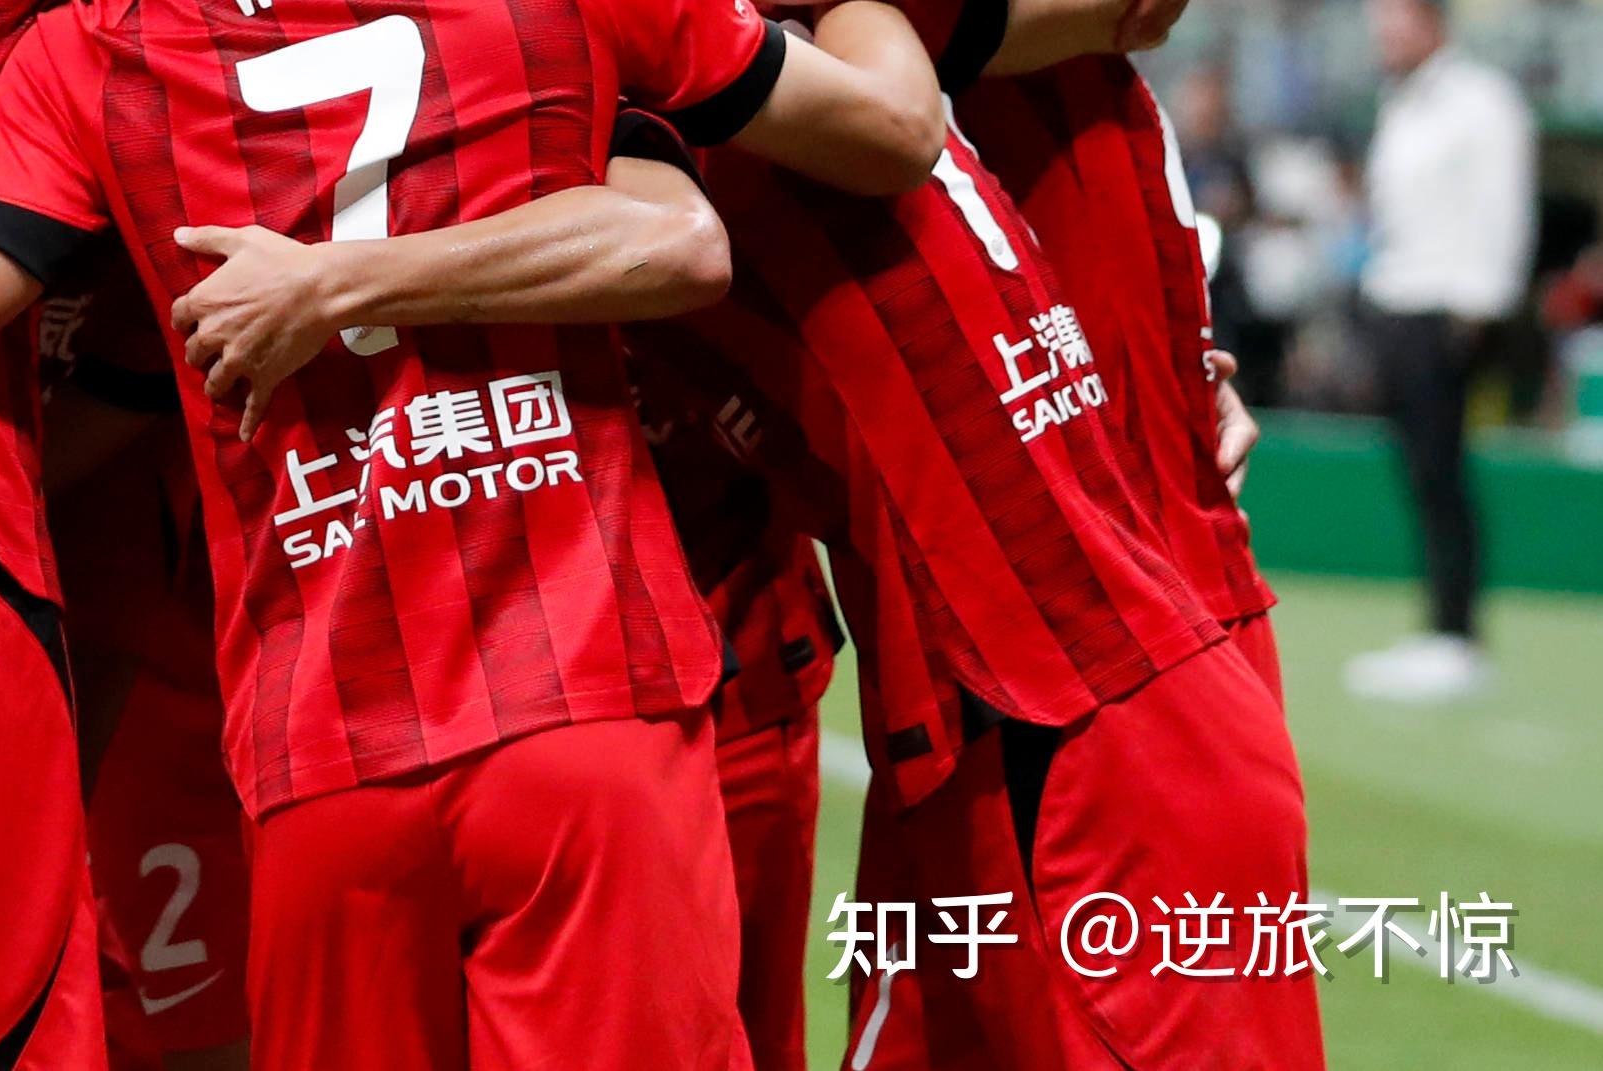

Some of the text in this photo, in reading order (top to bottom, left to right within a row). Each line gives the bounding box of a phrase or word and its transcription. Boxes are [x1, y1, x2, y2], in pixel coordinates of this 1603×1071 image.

[235, 15, 425, 356] 7
[273, 370, 572, 526] 上汽集团
[1012, 385, 1082, 443] SAIC
[379, 450, 583, 520] MOTOR
[139, 842, 208, 972] 2
